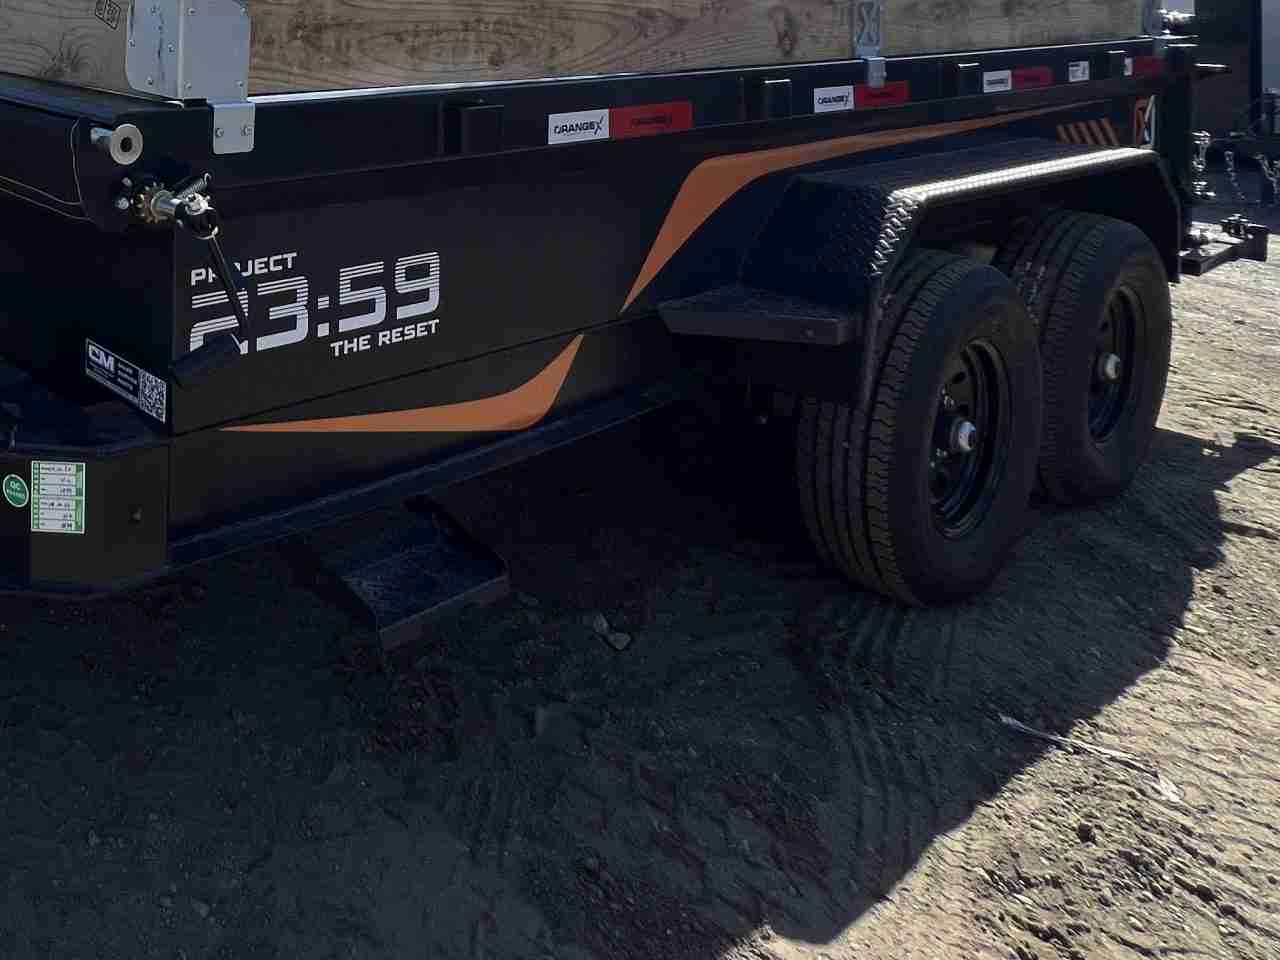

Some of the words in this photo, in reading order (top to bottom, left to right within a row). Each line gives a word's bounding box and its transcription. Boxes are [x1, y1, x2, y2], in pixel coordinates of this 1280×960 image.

[190, 252, 298, 286] PRJECT
[330, 334, 372, 357] THE
[378, 319, 440, 346] RESET
